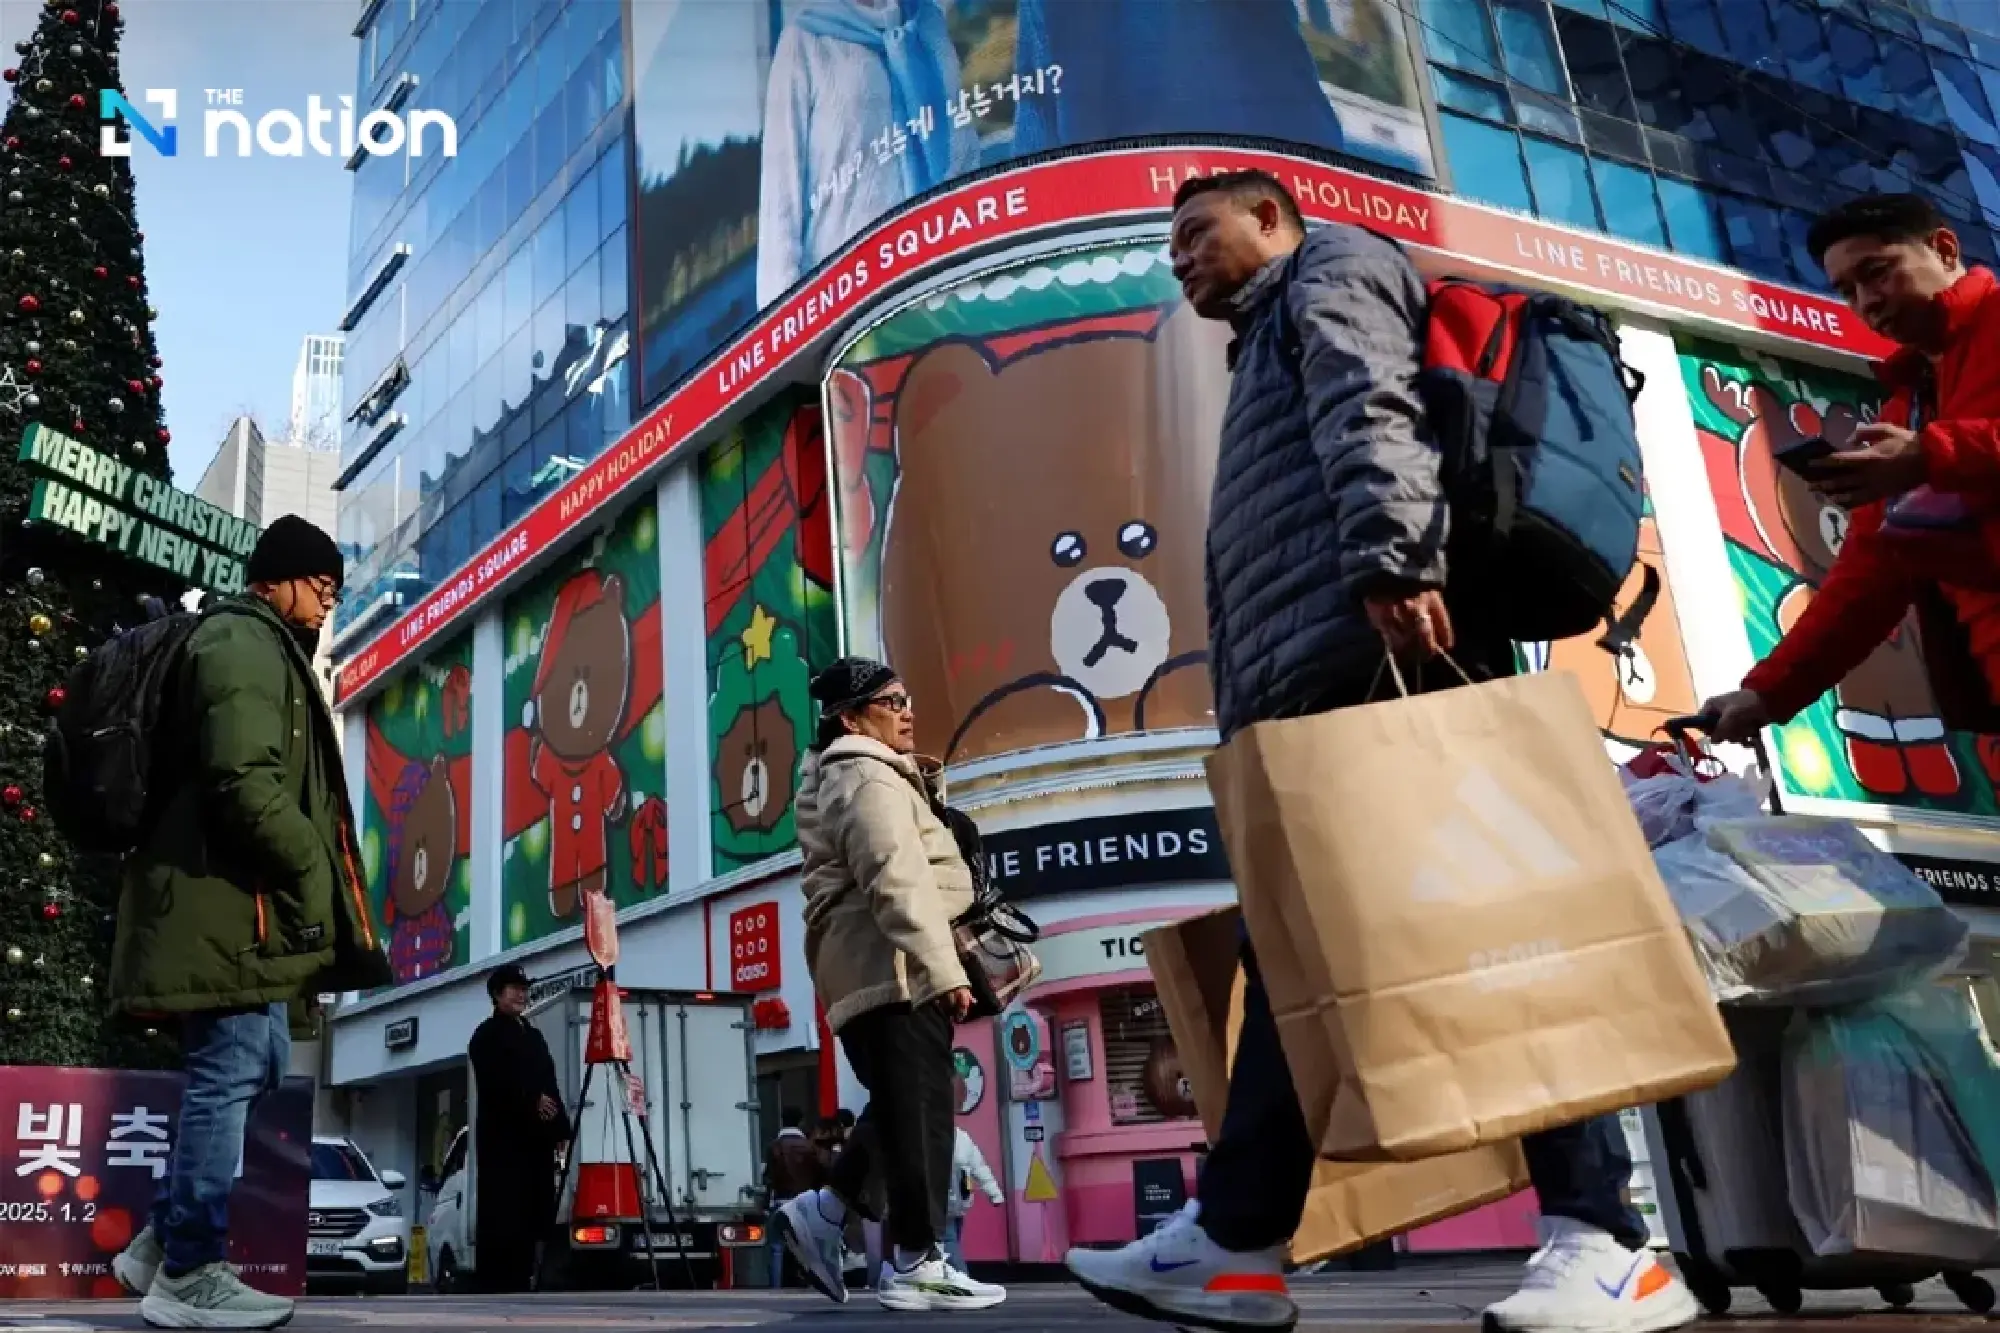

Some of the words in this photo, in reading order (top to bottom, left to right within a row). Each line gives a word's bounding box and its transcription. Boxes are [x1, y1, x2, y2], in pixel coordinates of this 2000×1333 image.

[946, 64, 1064, 129] 남는거지?
[1293, 175, 1429, 232] HOLIDAY
[719, 339, 766, 393] LINE
[771, 260, 869, 352] FRIENDS
[879, 187, 1029, 269] SQUARE
[1514, 232, 1588, 271] LINE
[1597, 252, 1722, 306] FRIENDS
[1731, 288, 1845, 337] SQUARE
[31, 424, 133, 500] MERRY
[133, 471, 263, 556] CHRISTMA
[560, 468, 604, 520] HAPPY
[608, 413, 673, 483] HOLIDAY
[42, 480, 139, 551] HAPPY
[137, 520, 200, 578] NEW
[200, 547, 249, 596] YEA
[401, 612, 425, 647] LINE
[427, 573, 475, 626] FRIENDS
[477, 530, 528, 585] SQUARE
[1036, 828, 1208, 872] FRIENDS
[1914, 867, 1989, 891] FRIENDS
[1100, 935, 1145, 959] TIC
[15, 1102, 82, 1177] 빛
[60, 1202, 77, 1222] 1.
